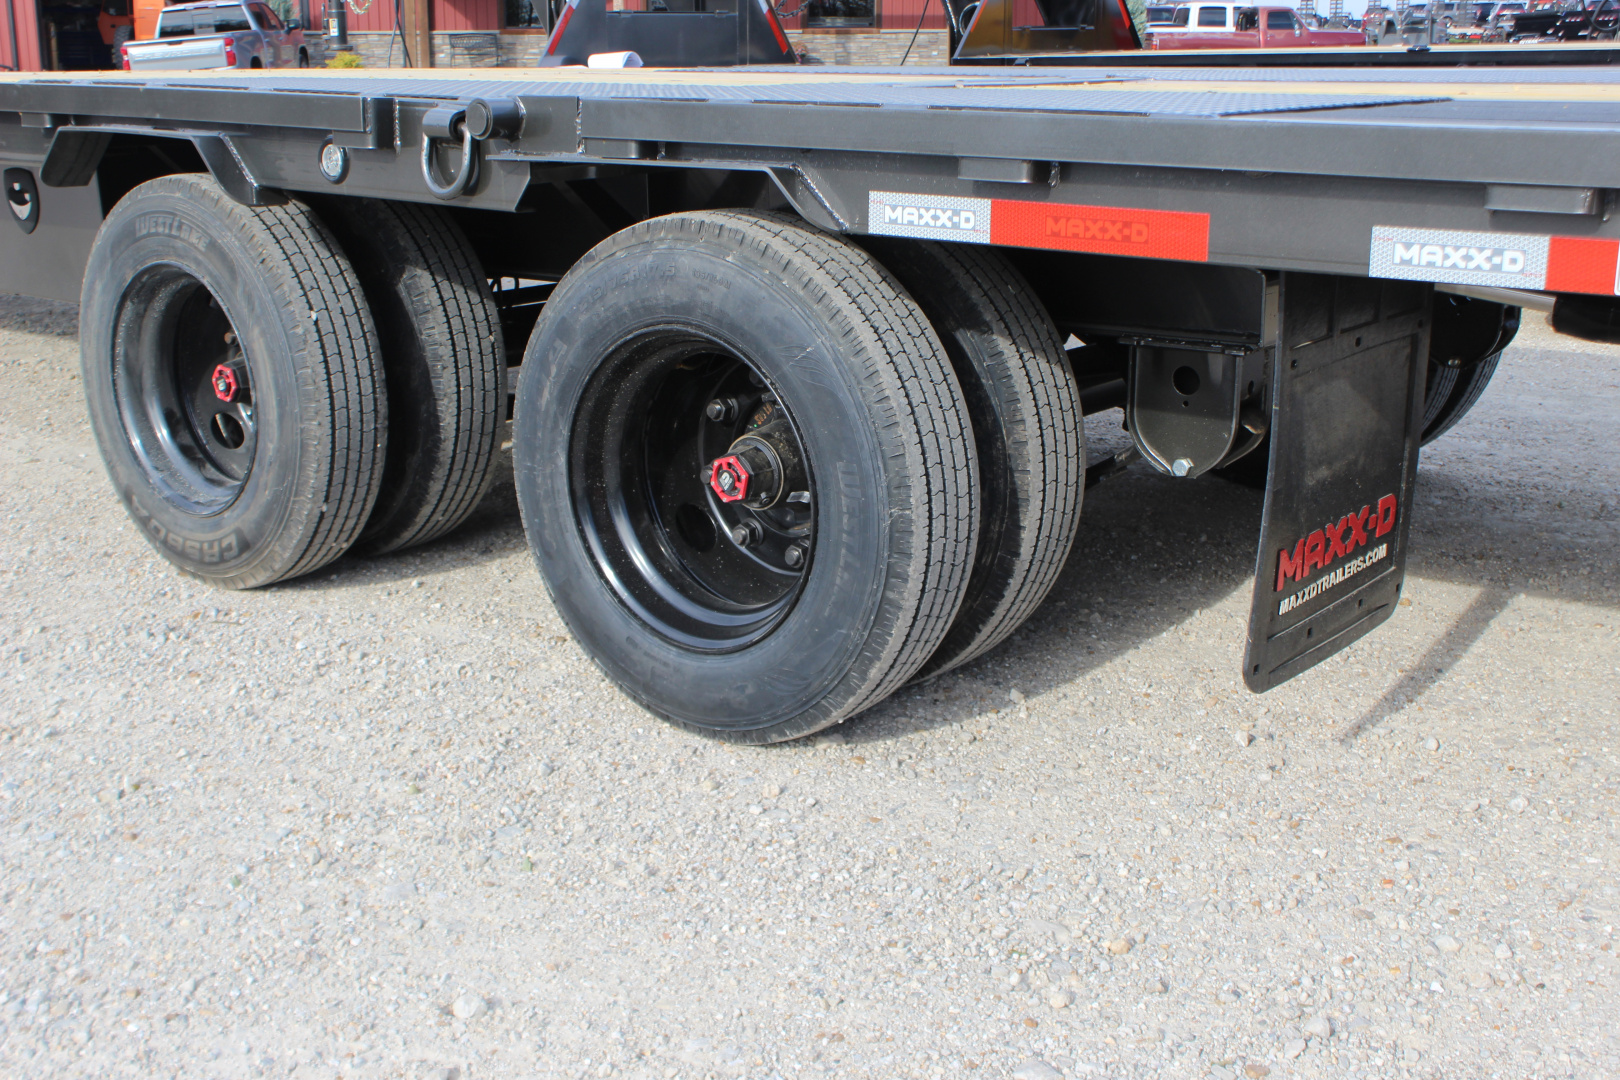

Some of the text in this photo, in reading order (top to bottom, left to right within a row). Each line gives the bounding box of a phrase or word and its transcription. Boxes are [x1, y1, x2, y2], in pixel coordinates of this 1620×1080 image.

[884, 204, 975, 230] MAXX-D
[1045, 216, 1149, 243] MAXX-D
[1393, 242, 1526, 273] MAXX-D
[824, 461, 862, 617] WESTLA
[1274, 493, 1397, 592] MAXX-D
[1279, 543, 1388, 615] MAXXDTRAILERS.COM
